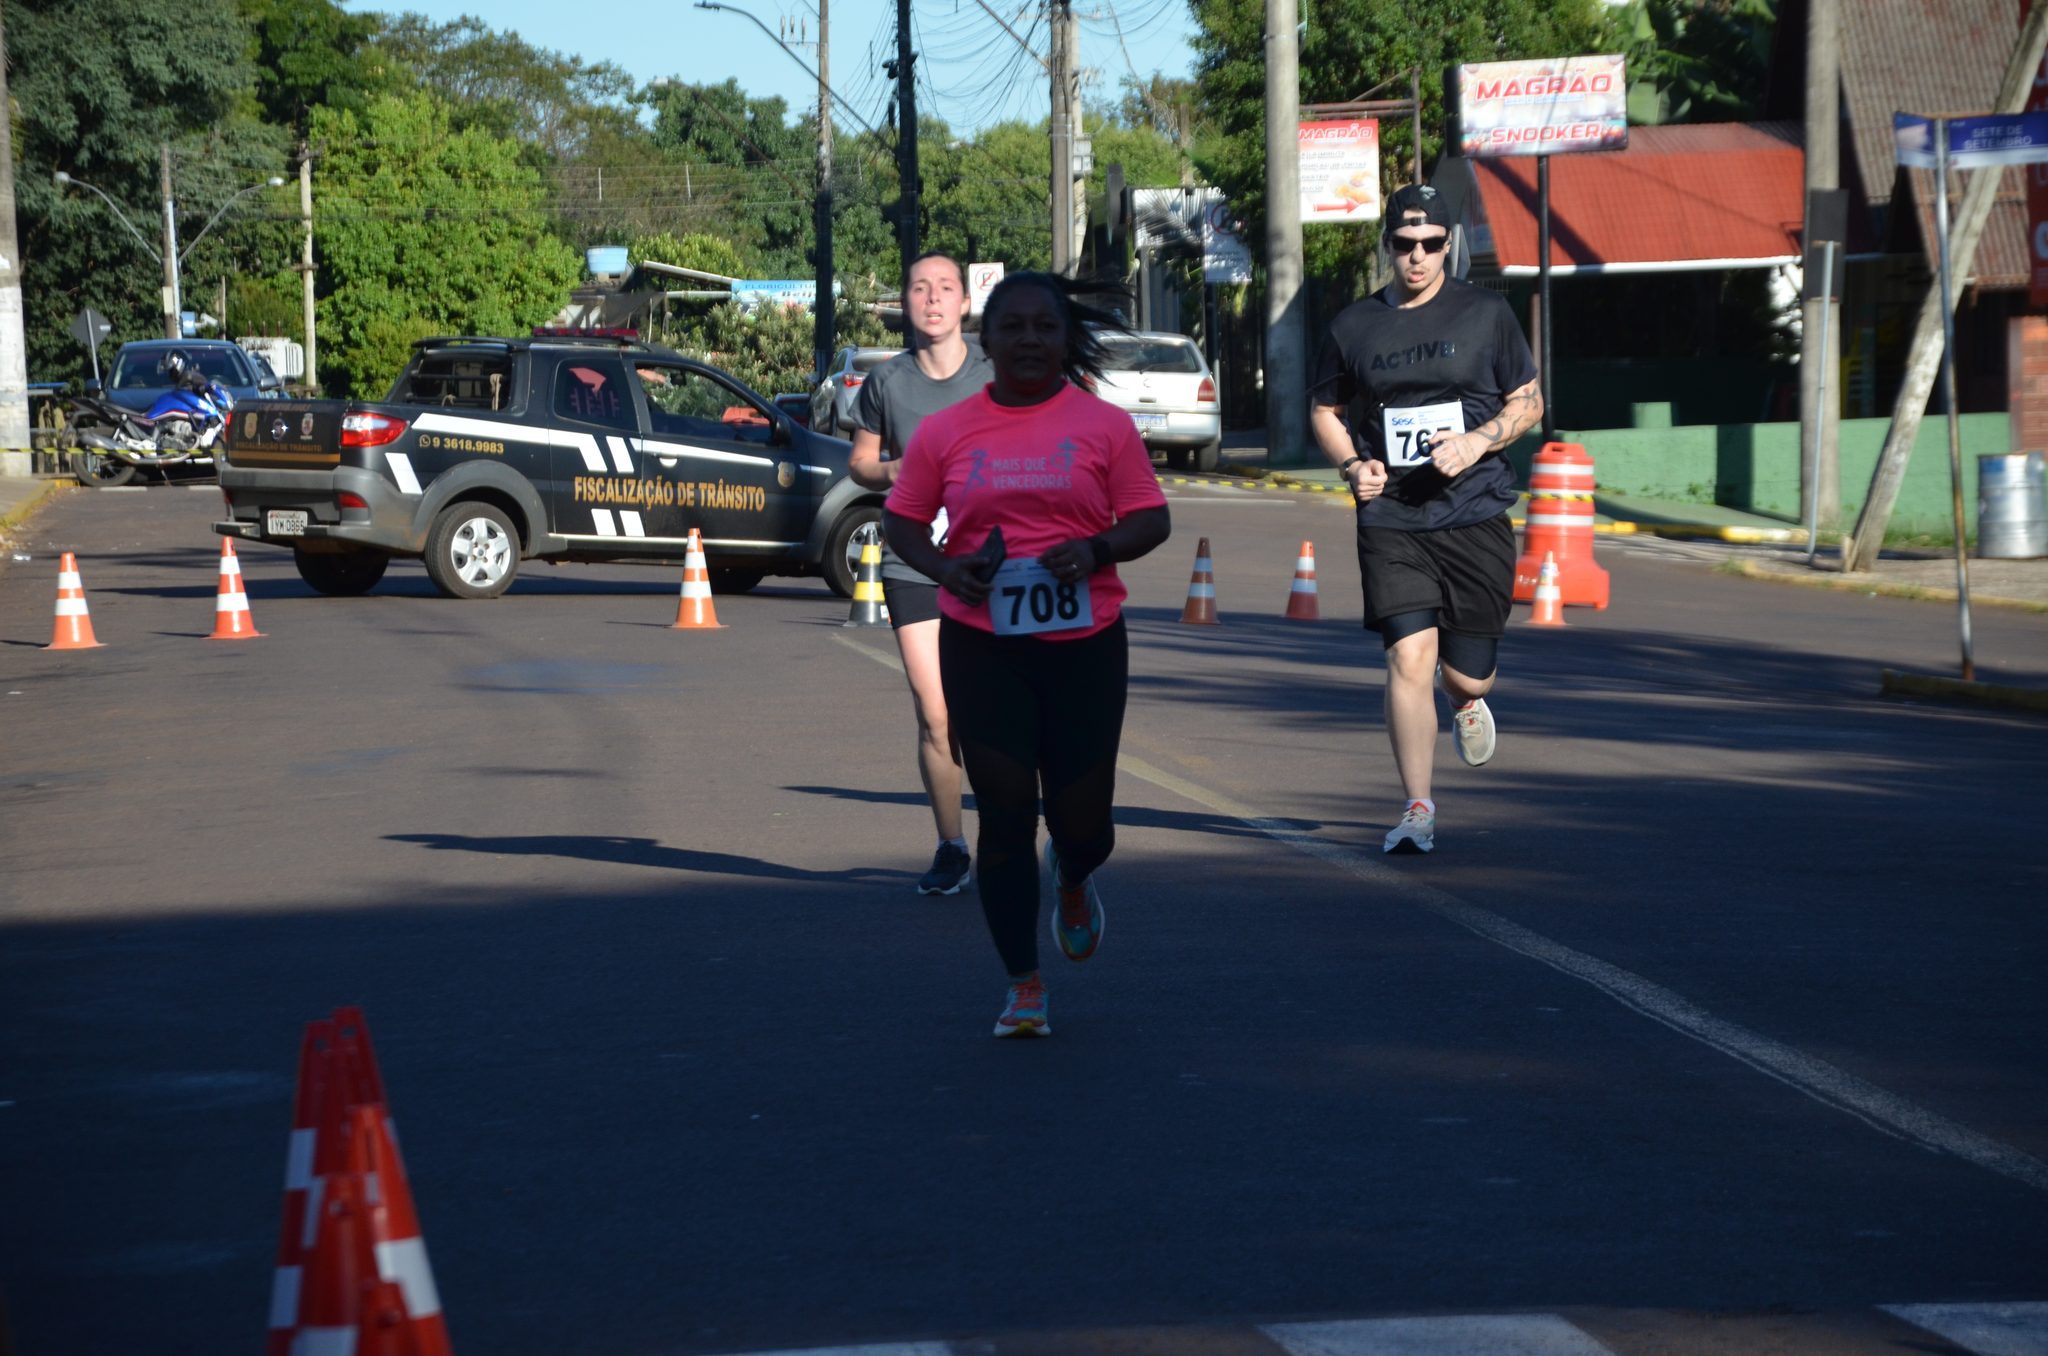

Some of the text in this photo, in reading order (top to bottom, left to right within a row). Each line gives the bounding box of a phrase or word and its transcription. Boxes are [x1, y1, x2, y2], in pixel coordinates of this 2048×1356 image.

[1476, 67, 1613, 100] MAGRÃO
[1299, 123, 1373, 140] MAGRÃO
[1491, 123, 1603, 145] SNOOKER
[1972, 124, 2024, 138] SETE DE
[1964, 135, 2033, 150] SETEMBRO
[1371, 341, 1456, 370] ACTIVE
[432, 436, 505, 455] 9 3618.9983
[1395, 426, 1452, 460] 76
[991, 456, 1048, 472] MAIS QUE
[992, 473, 1073, 490] VENCEDORAS
[574, 475, 766, 512] FISCALIZAÇÃO DE TRÂNSITO
[1002, 582, 1080, 626] 708
